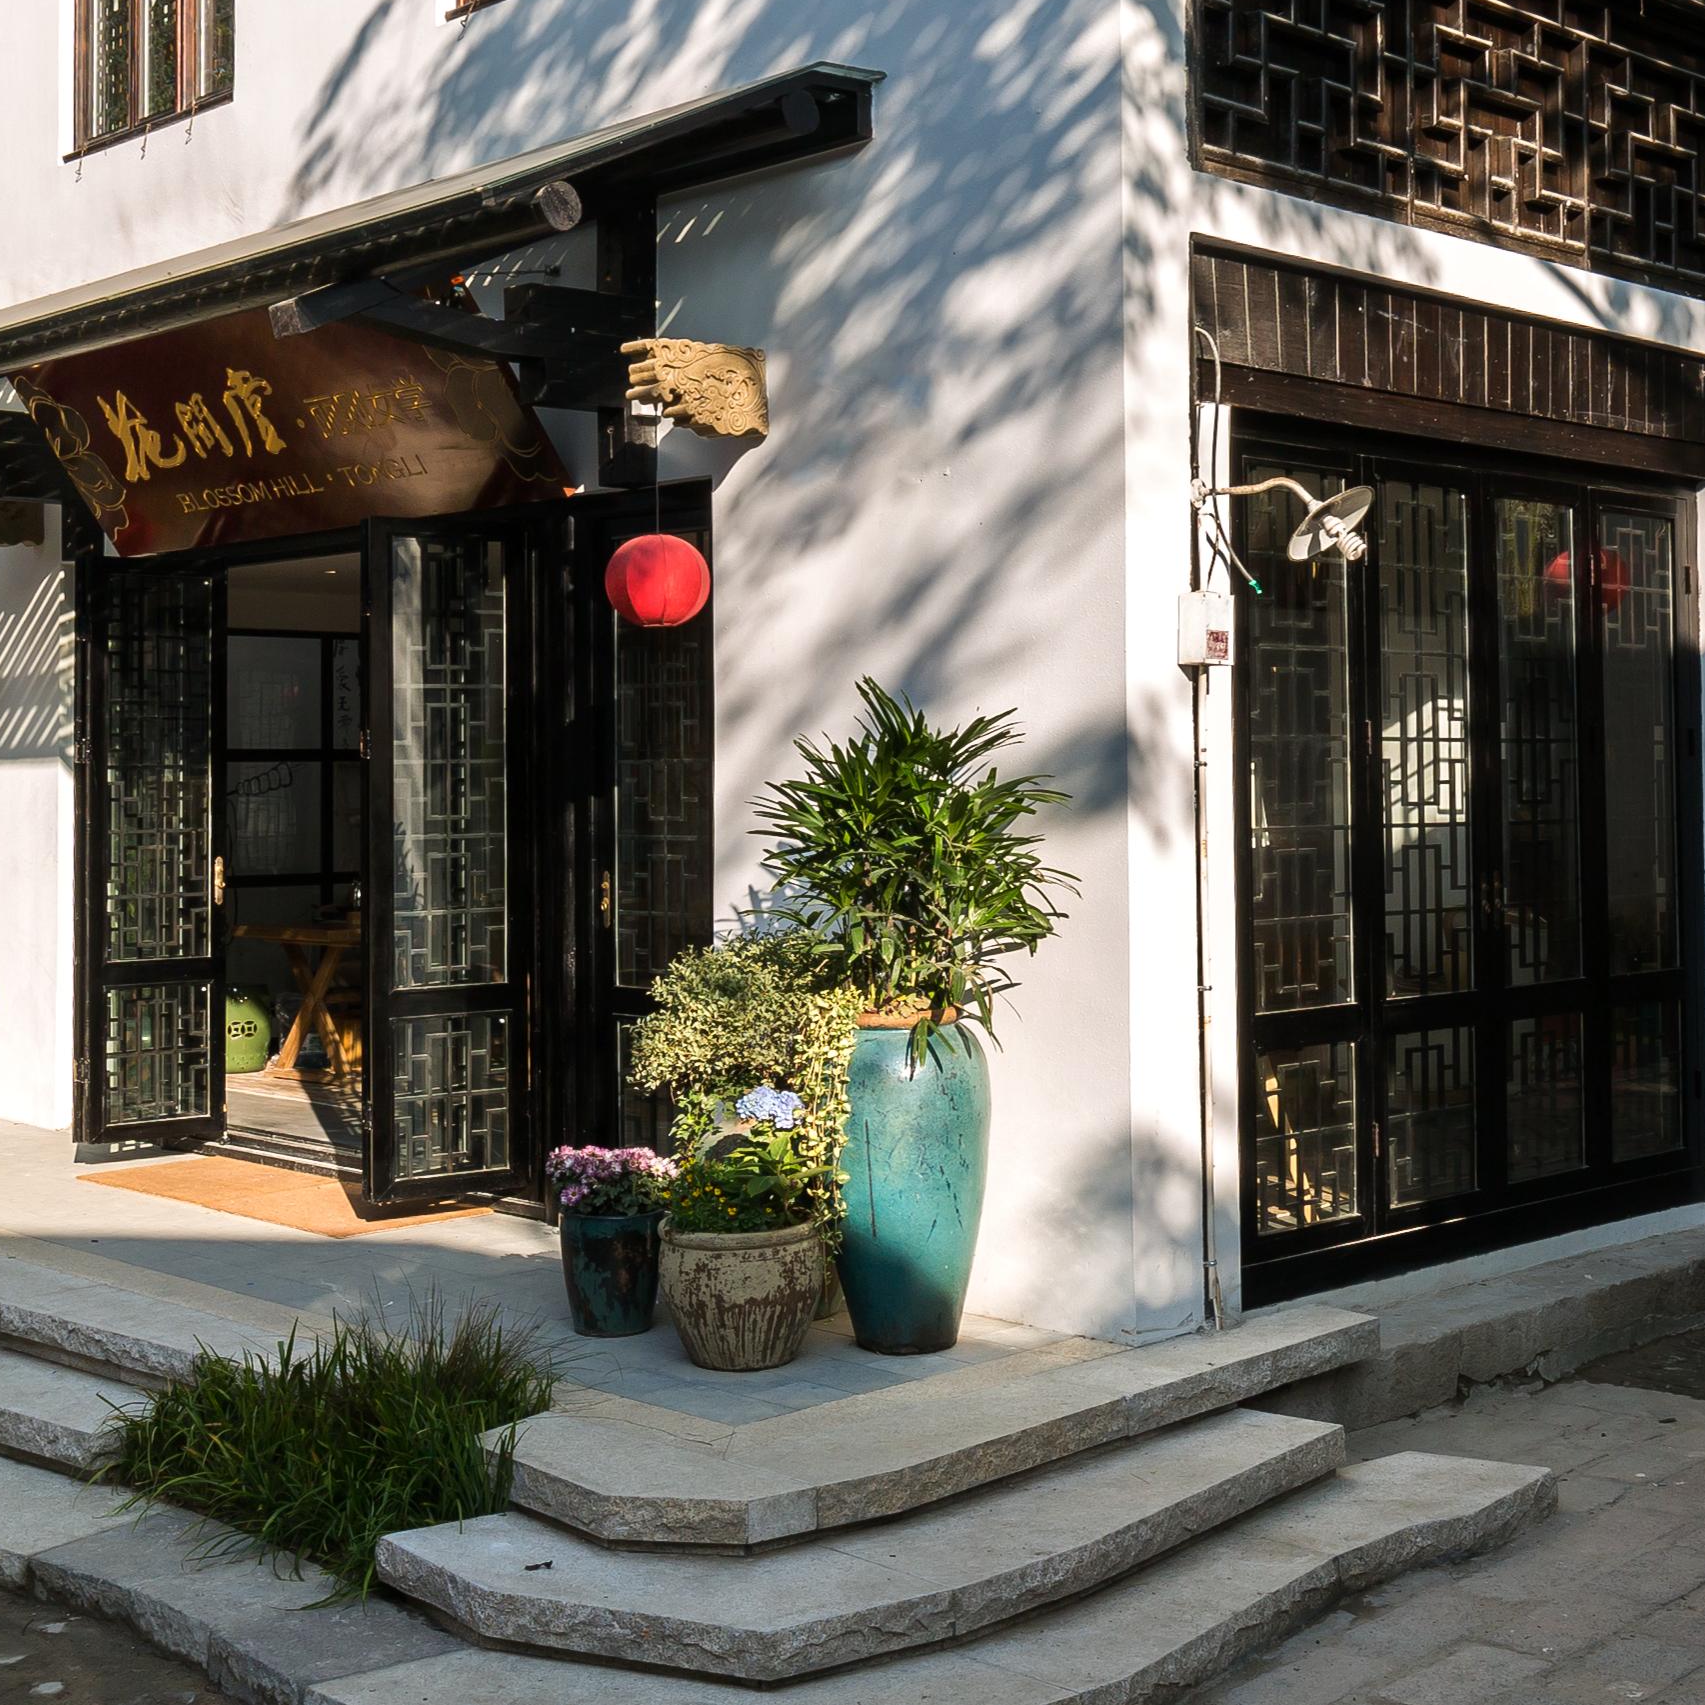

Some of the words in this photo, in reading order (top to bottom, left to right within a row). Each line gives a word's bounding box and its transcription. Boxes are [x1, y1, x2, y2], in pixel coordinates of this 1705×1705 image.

[176, 481, 273, 514] BLOSSOM
[269, 473, 325, 499] HILL
[337, 453, 429, 488] TONGLI
